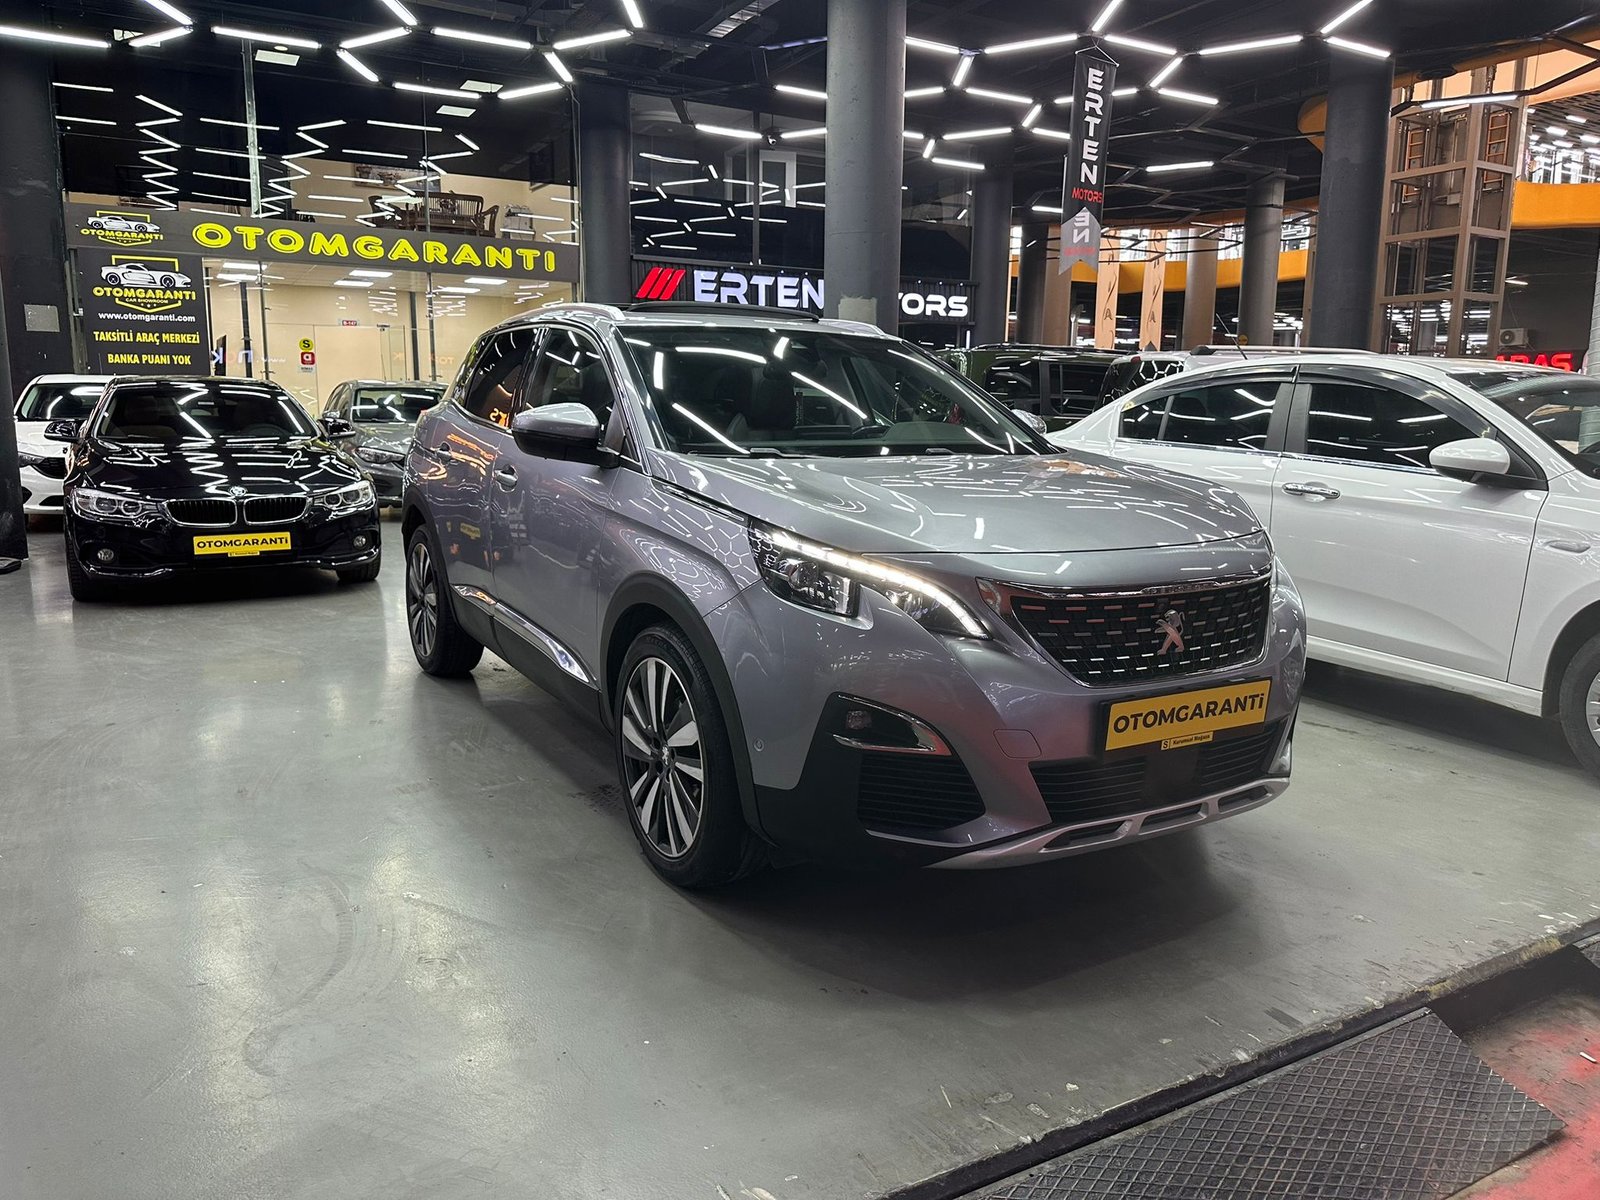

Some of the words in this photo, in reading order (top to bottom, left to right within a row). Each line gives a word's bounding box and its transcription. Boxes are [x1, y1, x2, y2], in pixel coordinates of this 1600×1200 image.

[1080, 67, 1104, 185] ERTEN
[1071, 187, 1103, 203] MOTORS
[80, 229, 164, 240] OTOMGARANTI
[191, 222, 556, 272] OTOMGARANTI
[92, 286, 196, 300] OTOMGARANTI
[693, 269, 825, 309] ERTEN
[897, 292, 969, 317] ORS
[98, 312, 196, 322] www.otomgaranti.com
[93, 329, 134, 342] TAKSİTLİ
[136, 333, 160, 346] ARAÇ
[162, 331, 200, 344] MERKEZİ
[107, 353, 140, 364] BANKA
[142, 354, 171, 365] PUANI
[172, 355, 191, 365] YOK
